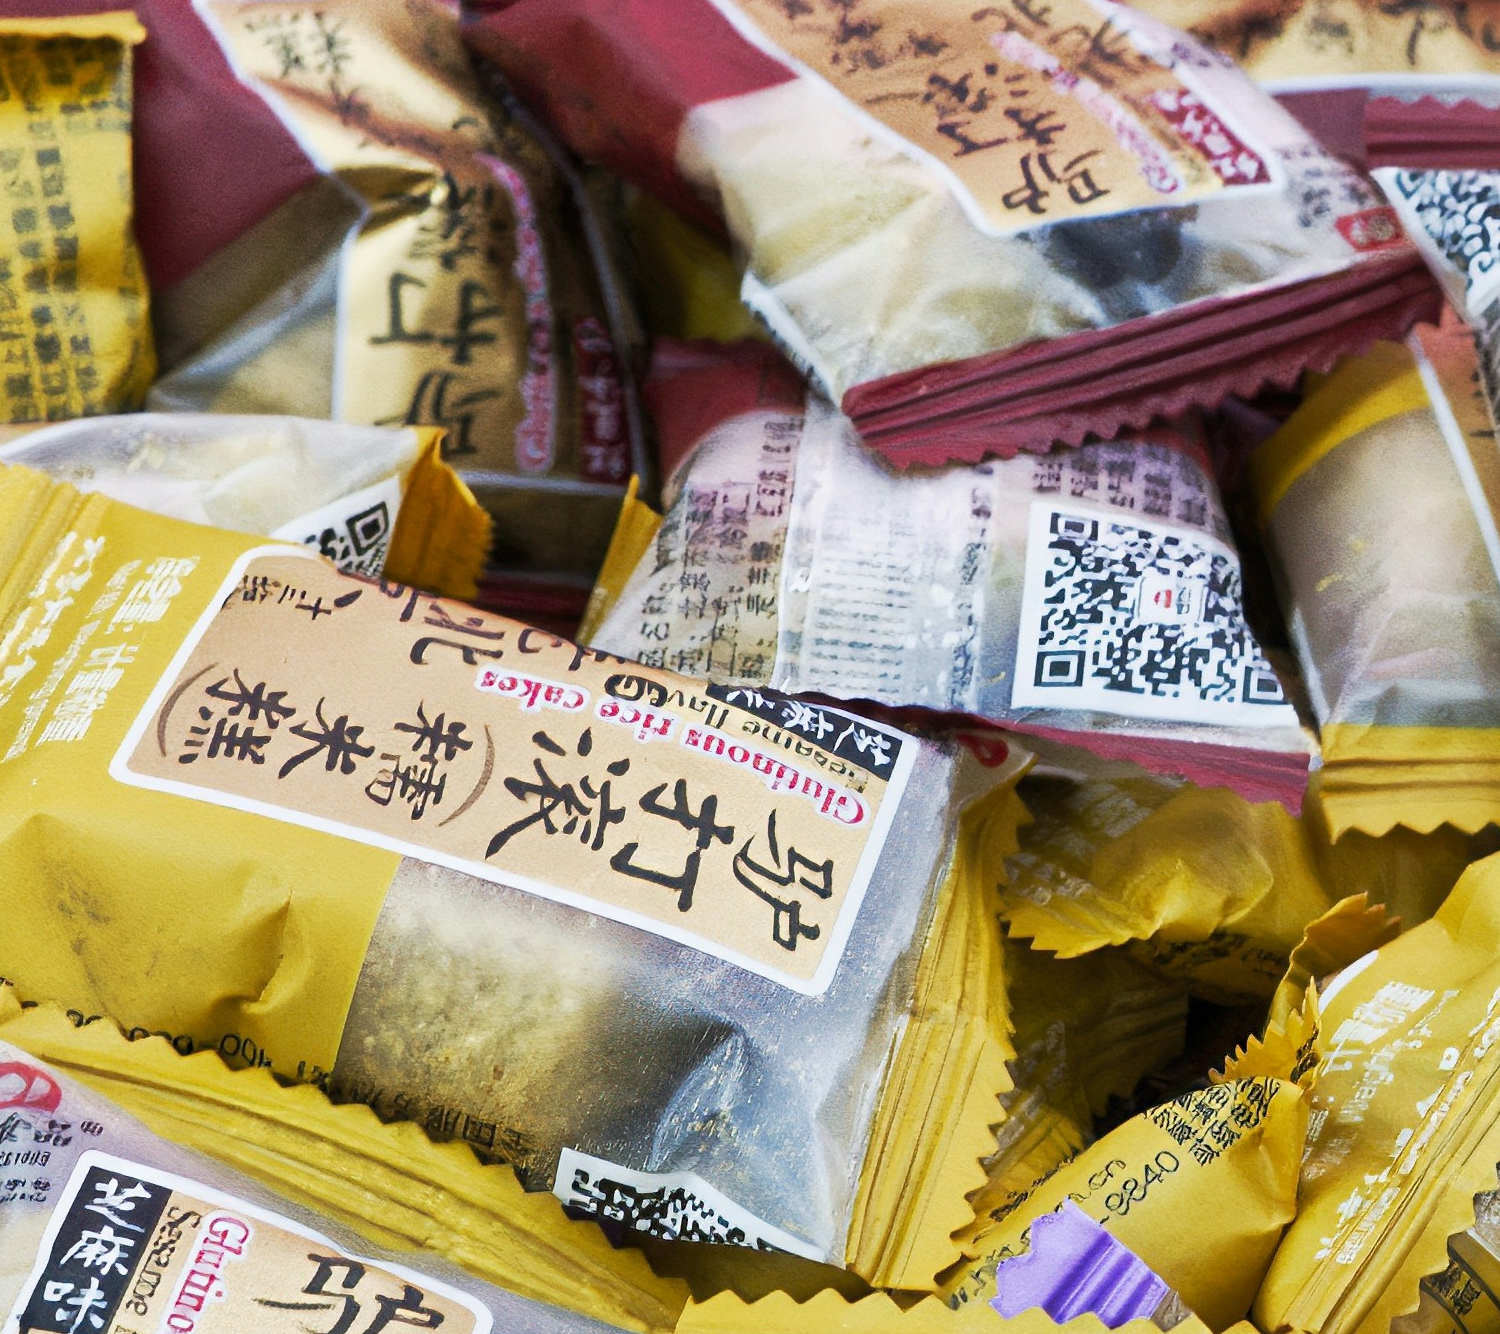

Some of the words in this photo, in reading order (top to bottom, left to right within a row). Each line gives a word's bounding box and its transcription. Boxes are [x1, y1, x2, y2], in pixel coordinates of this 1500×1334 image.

[481, 671, 587, 712] cakes
[600, 701, 675, 743] rice
[682, 725, 867, 825] Glutinous
[484, 725, 838, 953] 驴打滚
[43, 1176, 153, 1334] 芝麻味
